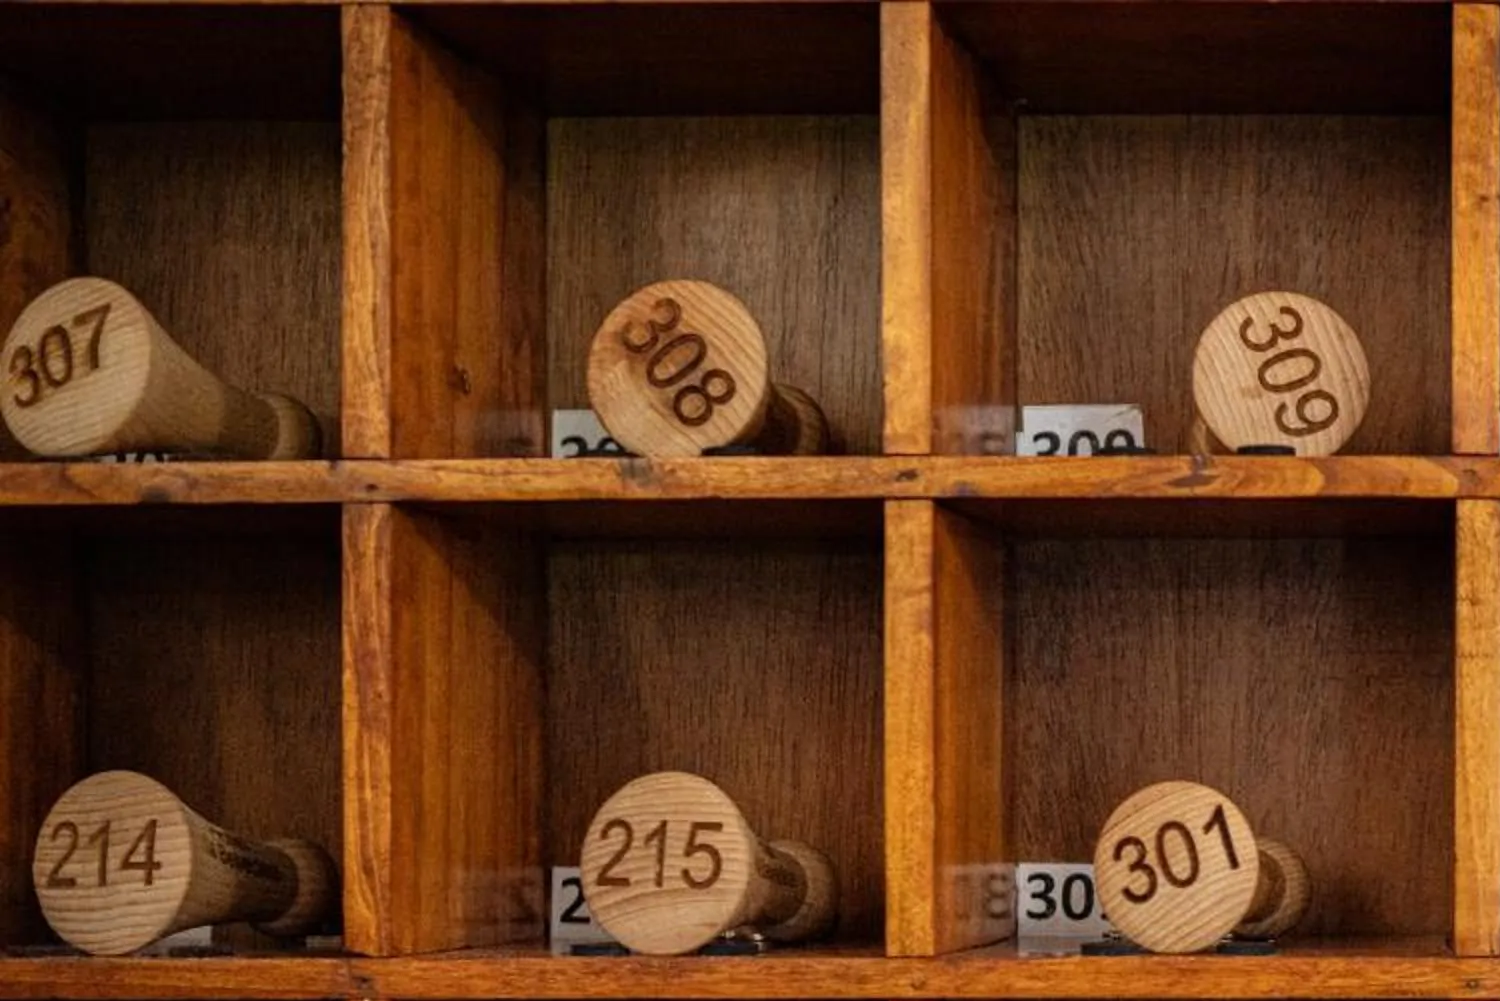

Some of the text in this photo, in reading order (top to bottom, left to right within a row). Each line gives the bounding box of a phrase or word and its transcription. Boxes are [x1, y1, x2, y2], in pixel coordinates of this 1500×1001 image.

[8, 303, 110, 408] 307
[622, 297, 736, 427] 308
[1239, 306, 1339, 437] 309
[45, 819, 163, 887] 214
[596, 818, 724, 889] 215
[1026, 872, 1107, 920] 30
[1112, 804, 1240, 904] 301
